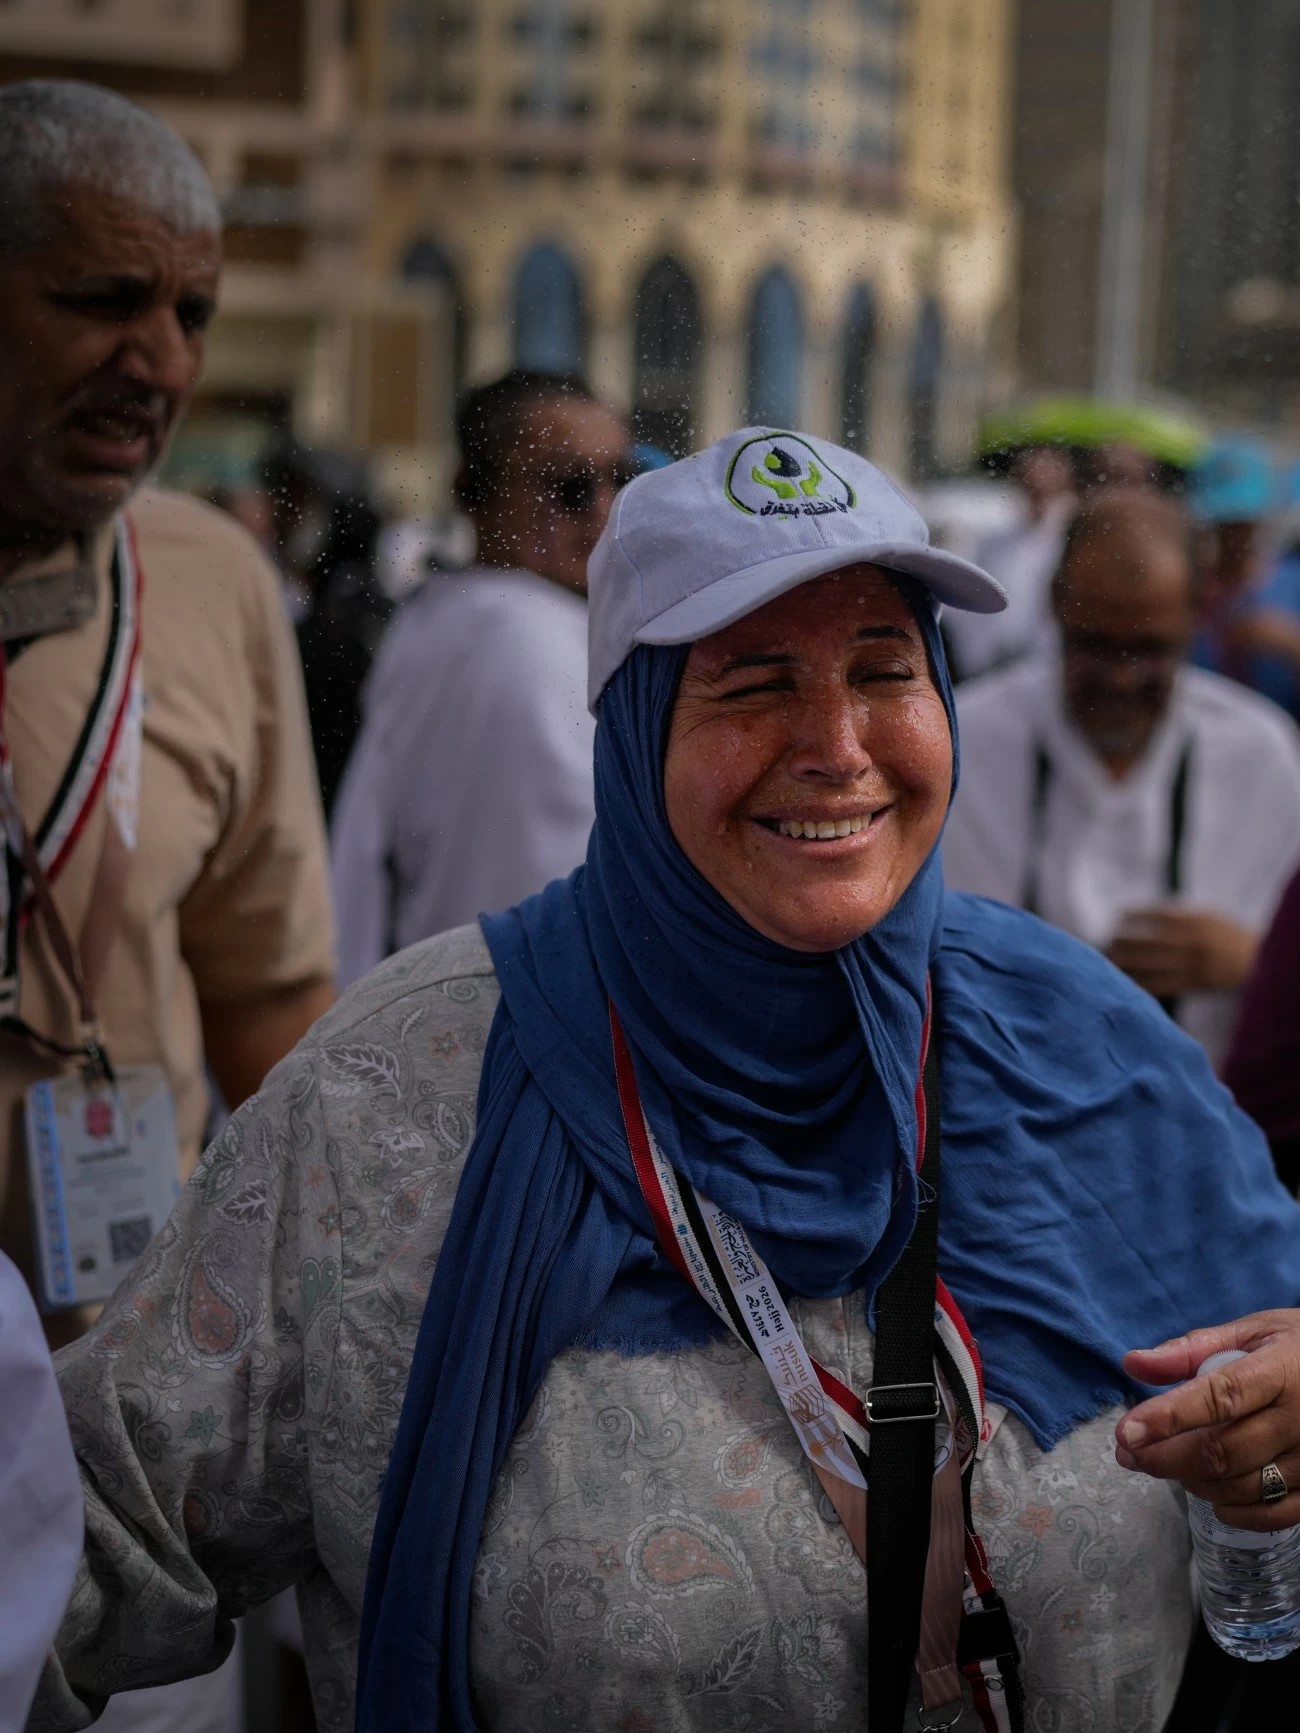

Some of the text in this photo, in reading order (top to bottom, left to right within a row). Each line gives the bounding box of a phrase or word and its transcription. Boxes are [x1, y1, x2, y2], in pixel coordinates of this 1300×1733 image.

[737, 1230, 746, 1243] HAJJ
[743, 1243, 749, 1251] OF
[746, 1251, 760, 1277] MINISTRY
[746, 1295, 760, 1310] حج
[758, 1286, 784, 1332] Hajj 2026
[784, 1340, 809, 1382] nusuk
